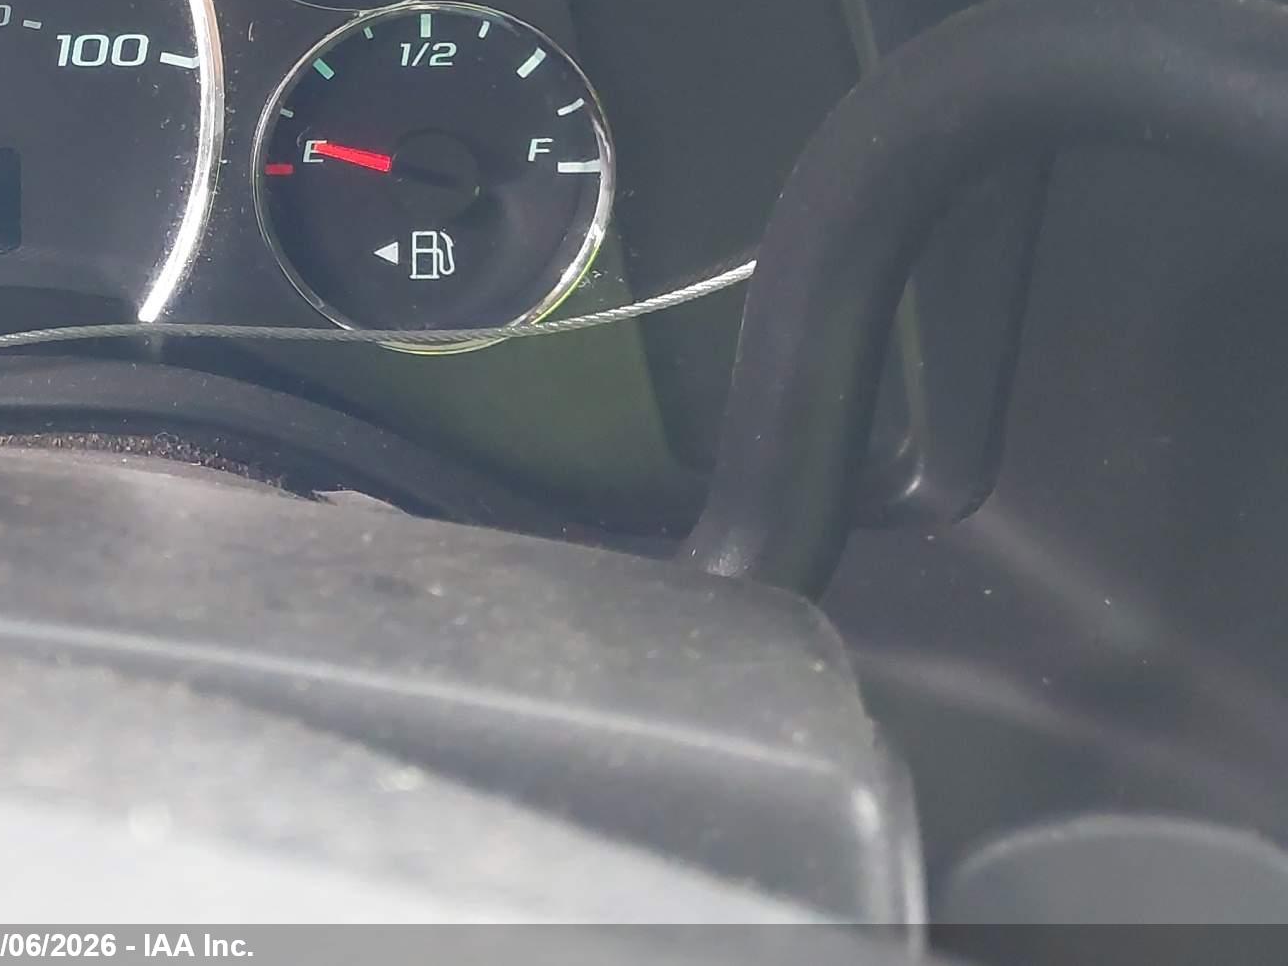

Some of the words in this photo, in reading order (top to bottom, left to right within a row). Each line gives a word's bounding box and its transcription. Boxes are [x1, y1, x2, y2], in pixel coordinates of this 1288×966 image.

[56, 34, 149, 67] 100
[400, 42, 456, 67] 1/2
[527, 137, 552, 162] F
